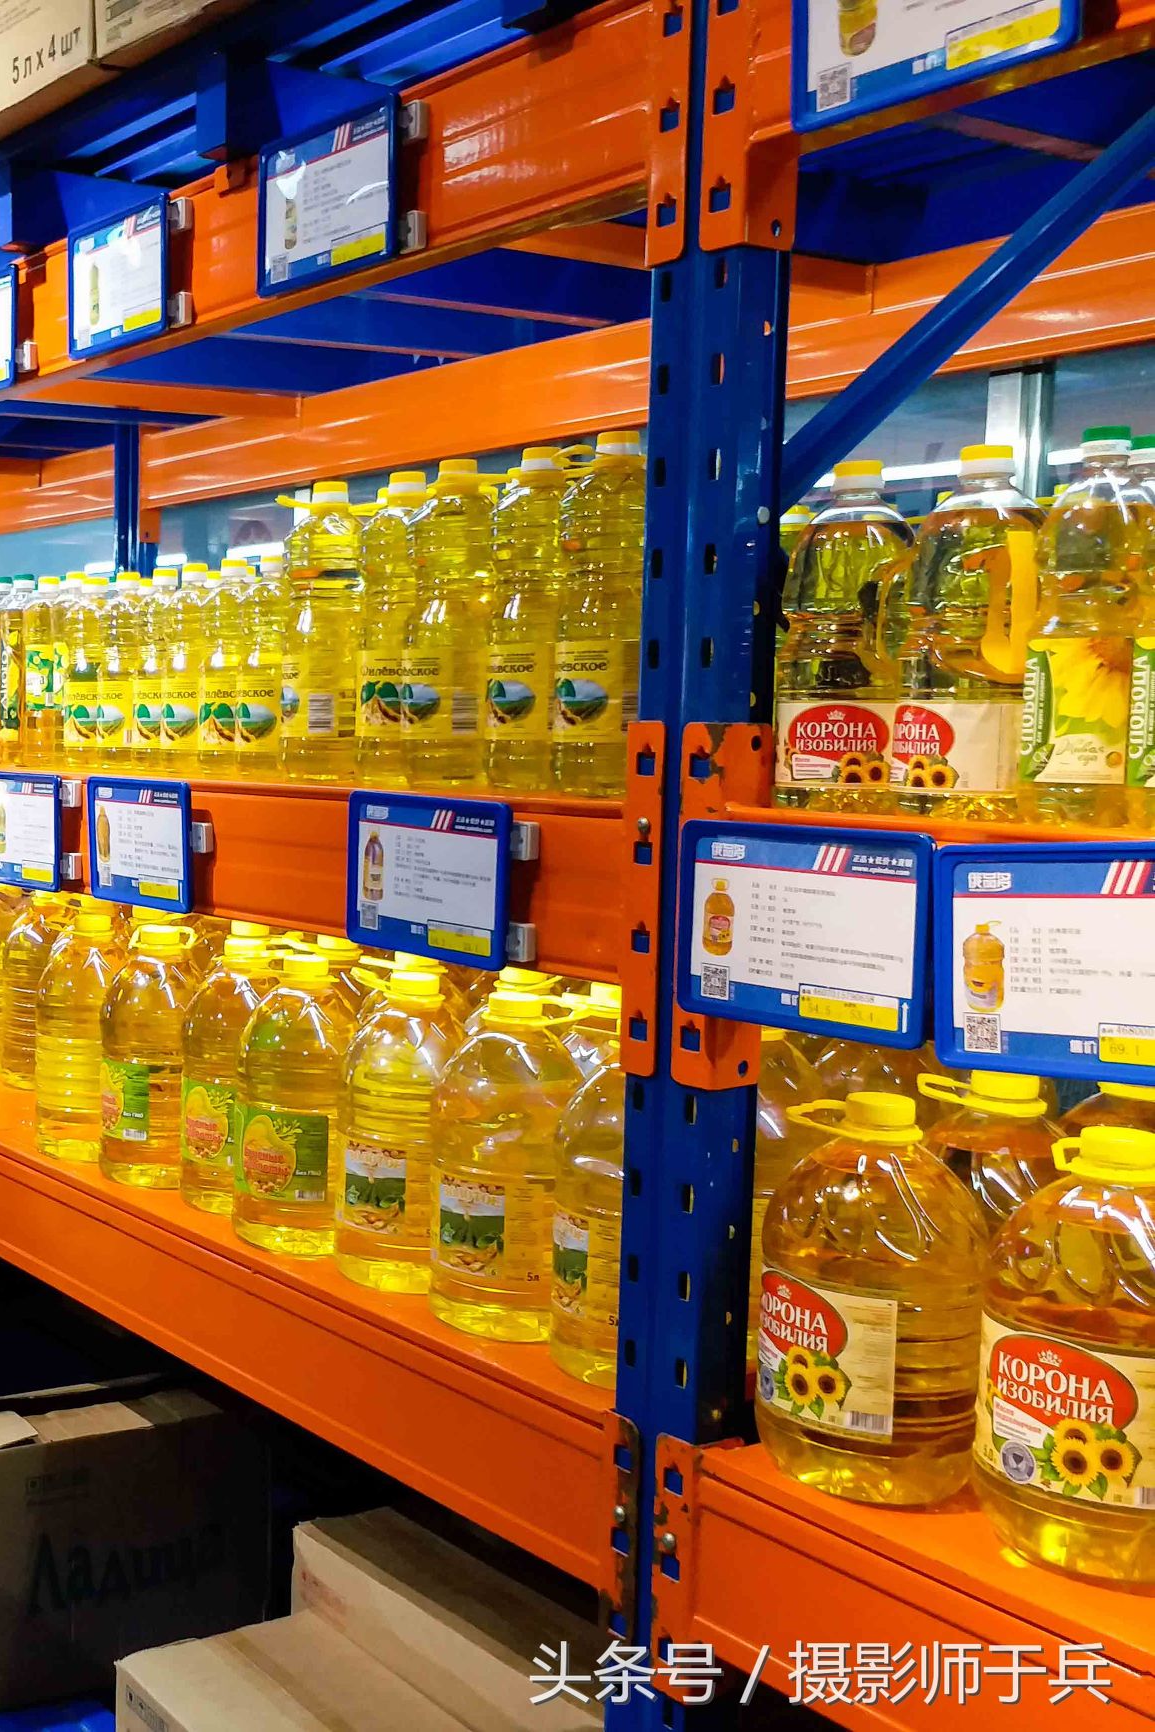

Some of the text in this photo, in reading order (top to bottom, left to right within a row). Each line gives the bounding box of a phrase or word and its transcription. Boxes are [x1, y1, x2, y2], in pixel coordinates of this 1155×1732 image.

[796, 721, 877, 739] КОРОНА
[1020, 657, 1038, 756] СЛОБОДА
[1128, 655, 1149, 759] СЛОБОДА
[795, 738, 877, 752] ИЗОБИЛИЯ
[894, 723, 940, 741] ОРОНА
[761, 1291, 828, 1336] ОРОНА
[996, 1374, 1114, 1425] ИЗОБИЛИЯ
[997, 1349, 1114, 1405] КОРОНА
